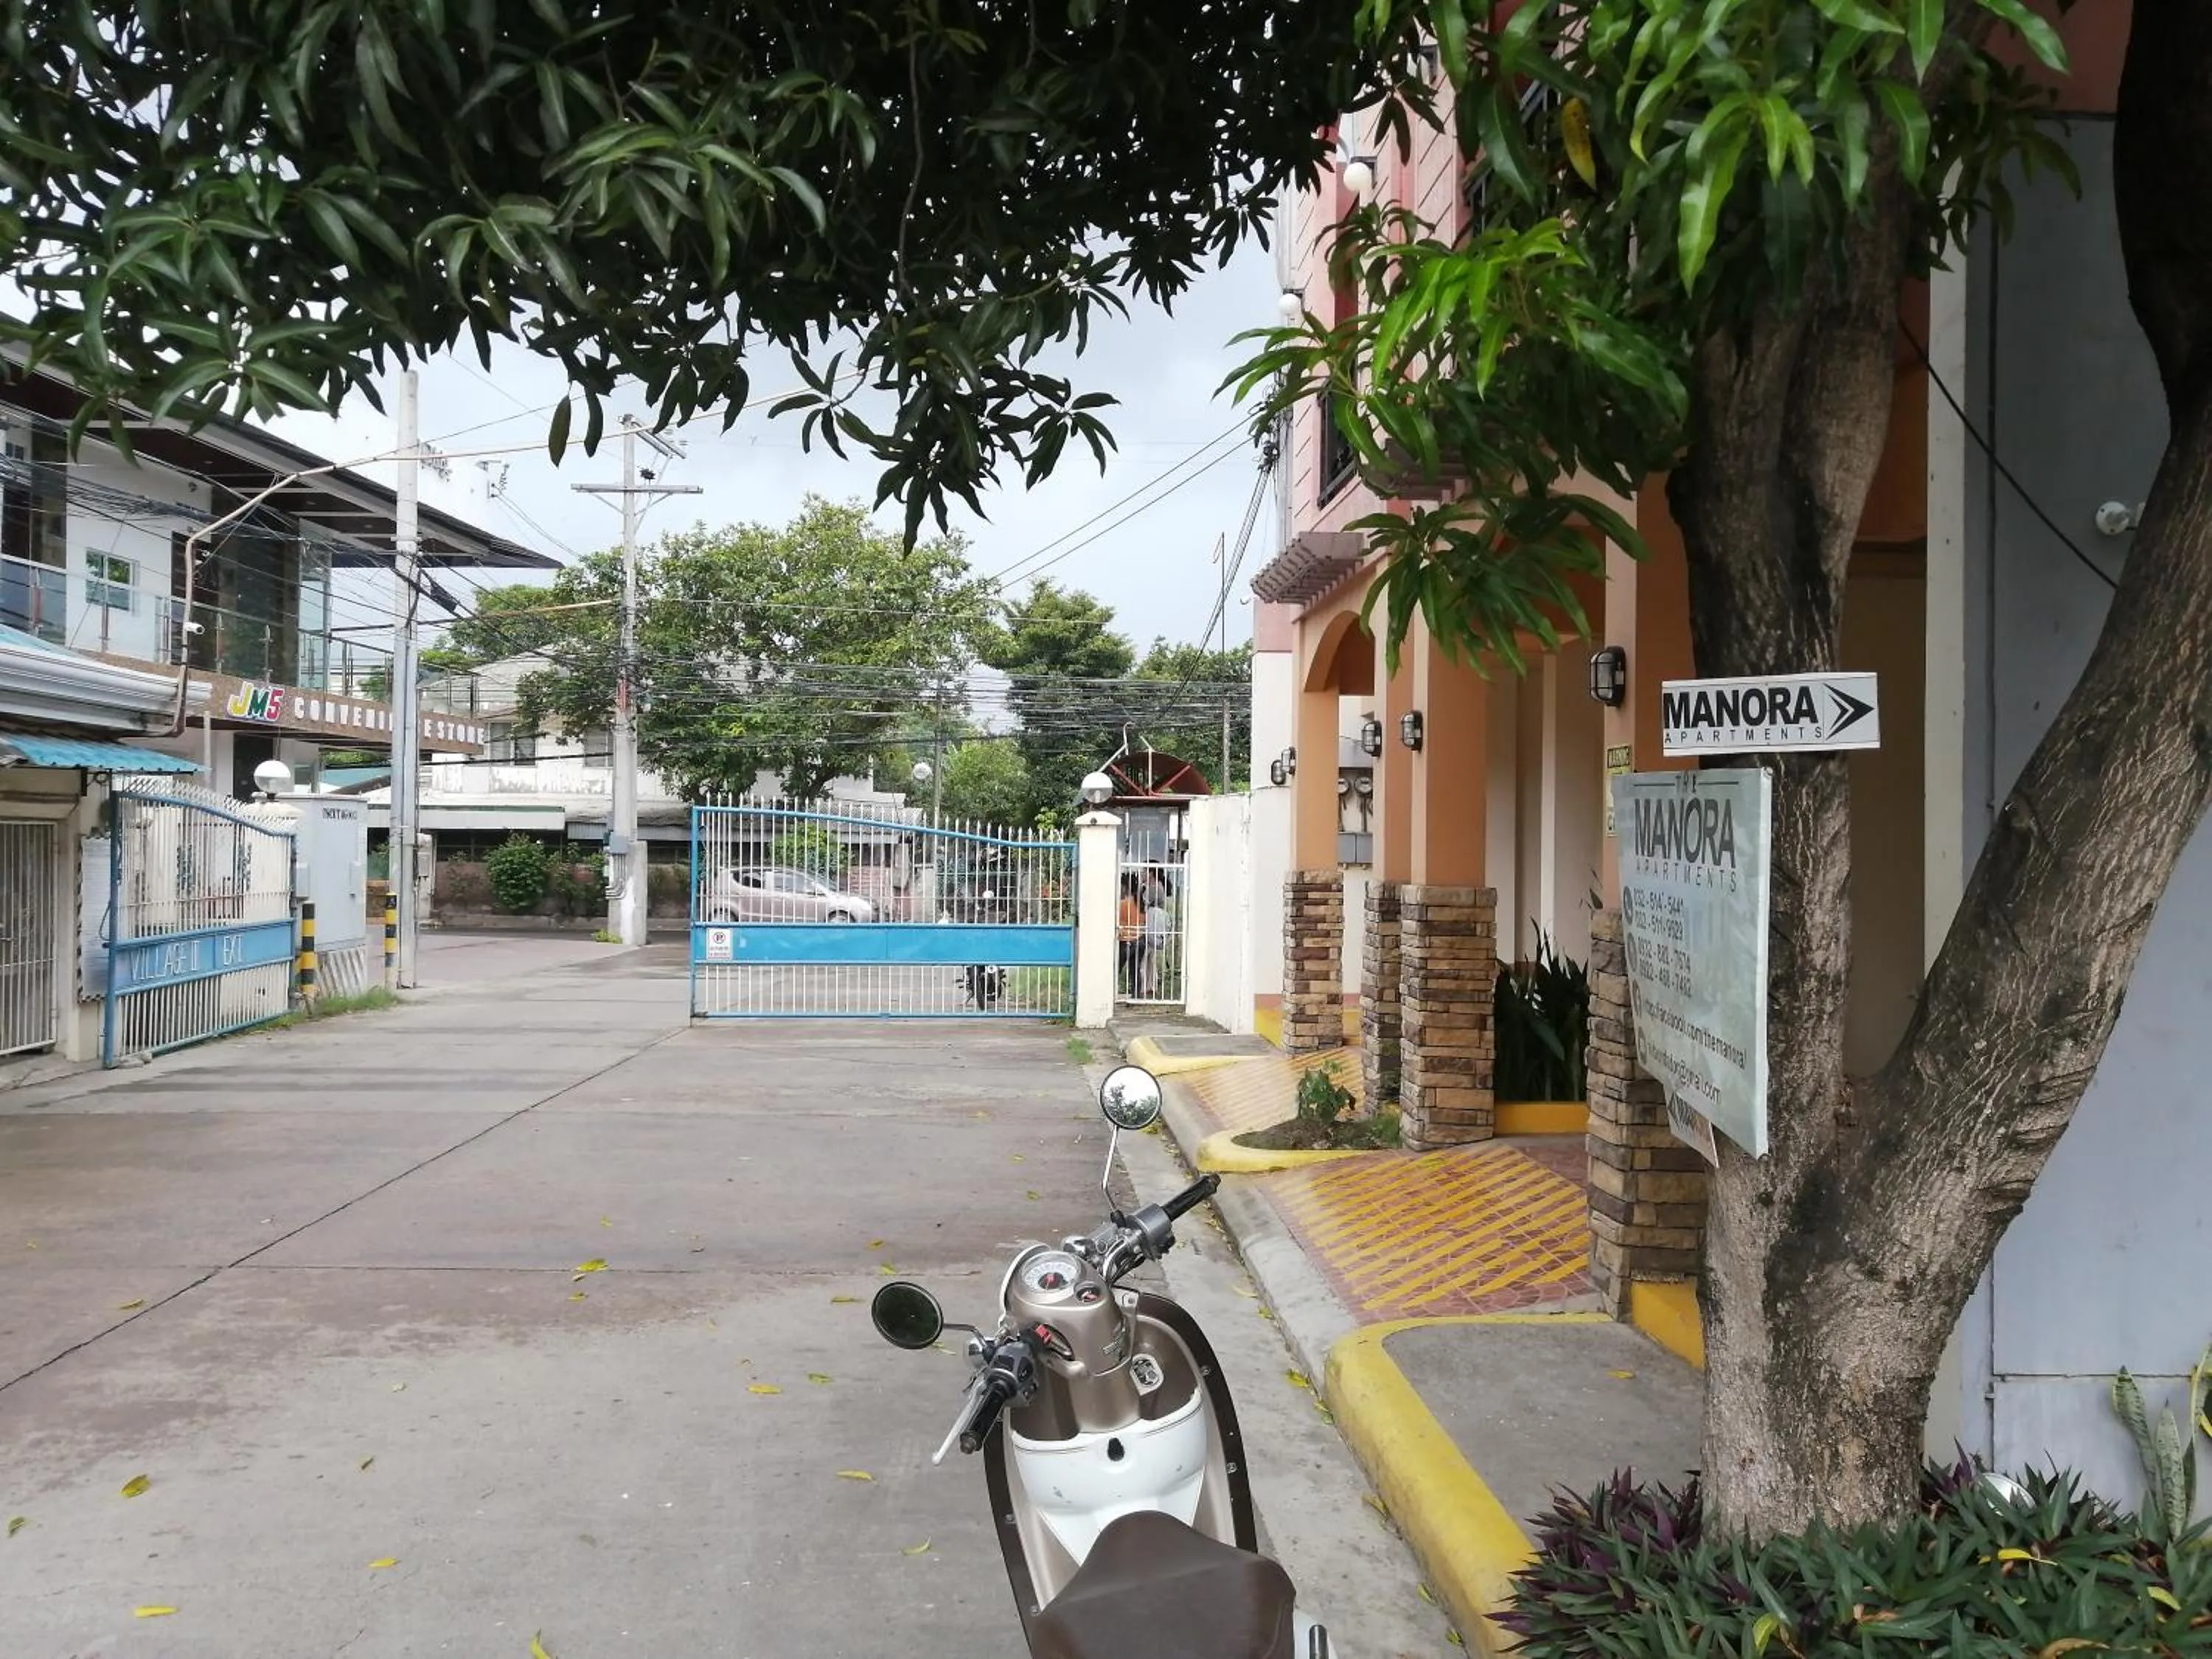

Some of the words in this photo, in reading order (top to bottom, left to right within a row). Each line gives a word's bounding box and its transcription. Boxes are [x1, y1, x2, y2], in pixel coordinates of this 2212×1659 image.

[1663, 686, 1819, 728] MANORA
[1664, 726, 1823, 743] APARTMENTS
[1634, 796, 1736, 869] MANORA
